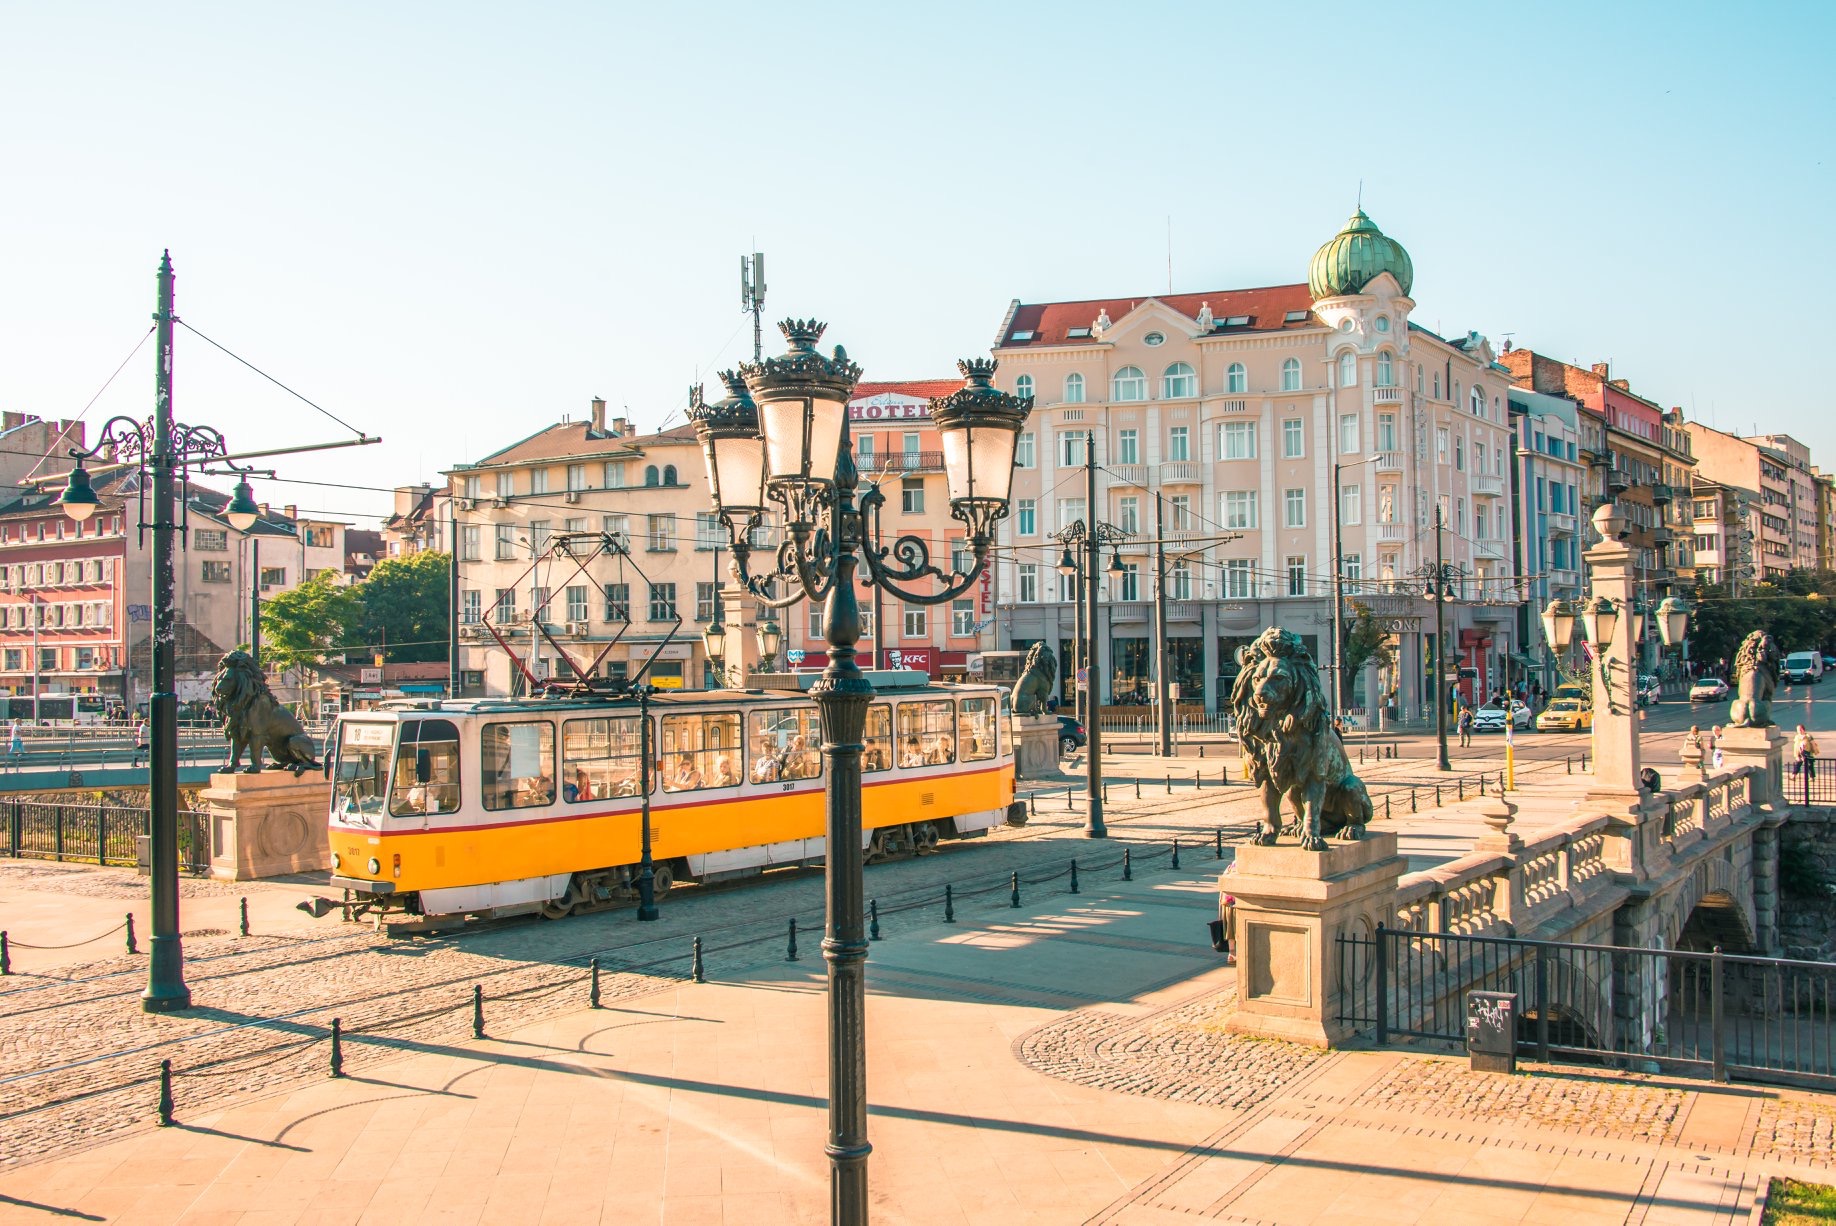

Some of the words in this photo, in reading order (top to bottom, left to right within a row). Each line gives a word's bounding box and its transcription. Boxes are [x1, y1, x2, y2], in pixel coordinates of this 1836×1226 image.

[848, 405, 931, 419] HOTEL
[903, 655, 927, 664] KFC
[783, 783, 795, 791] 3017
